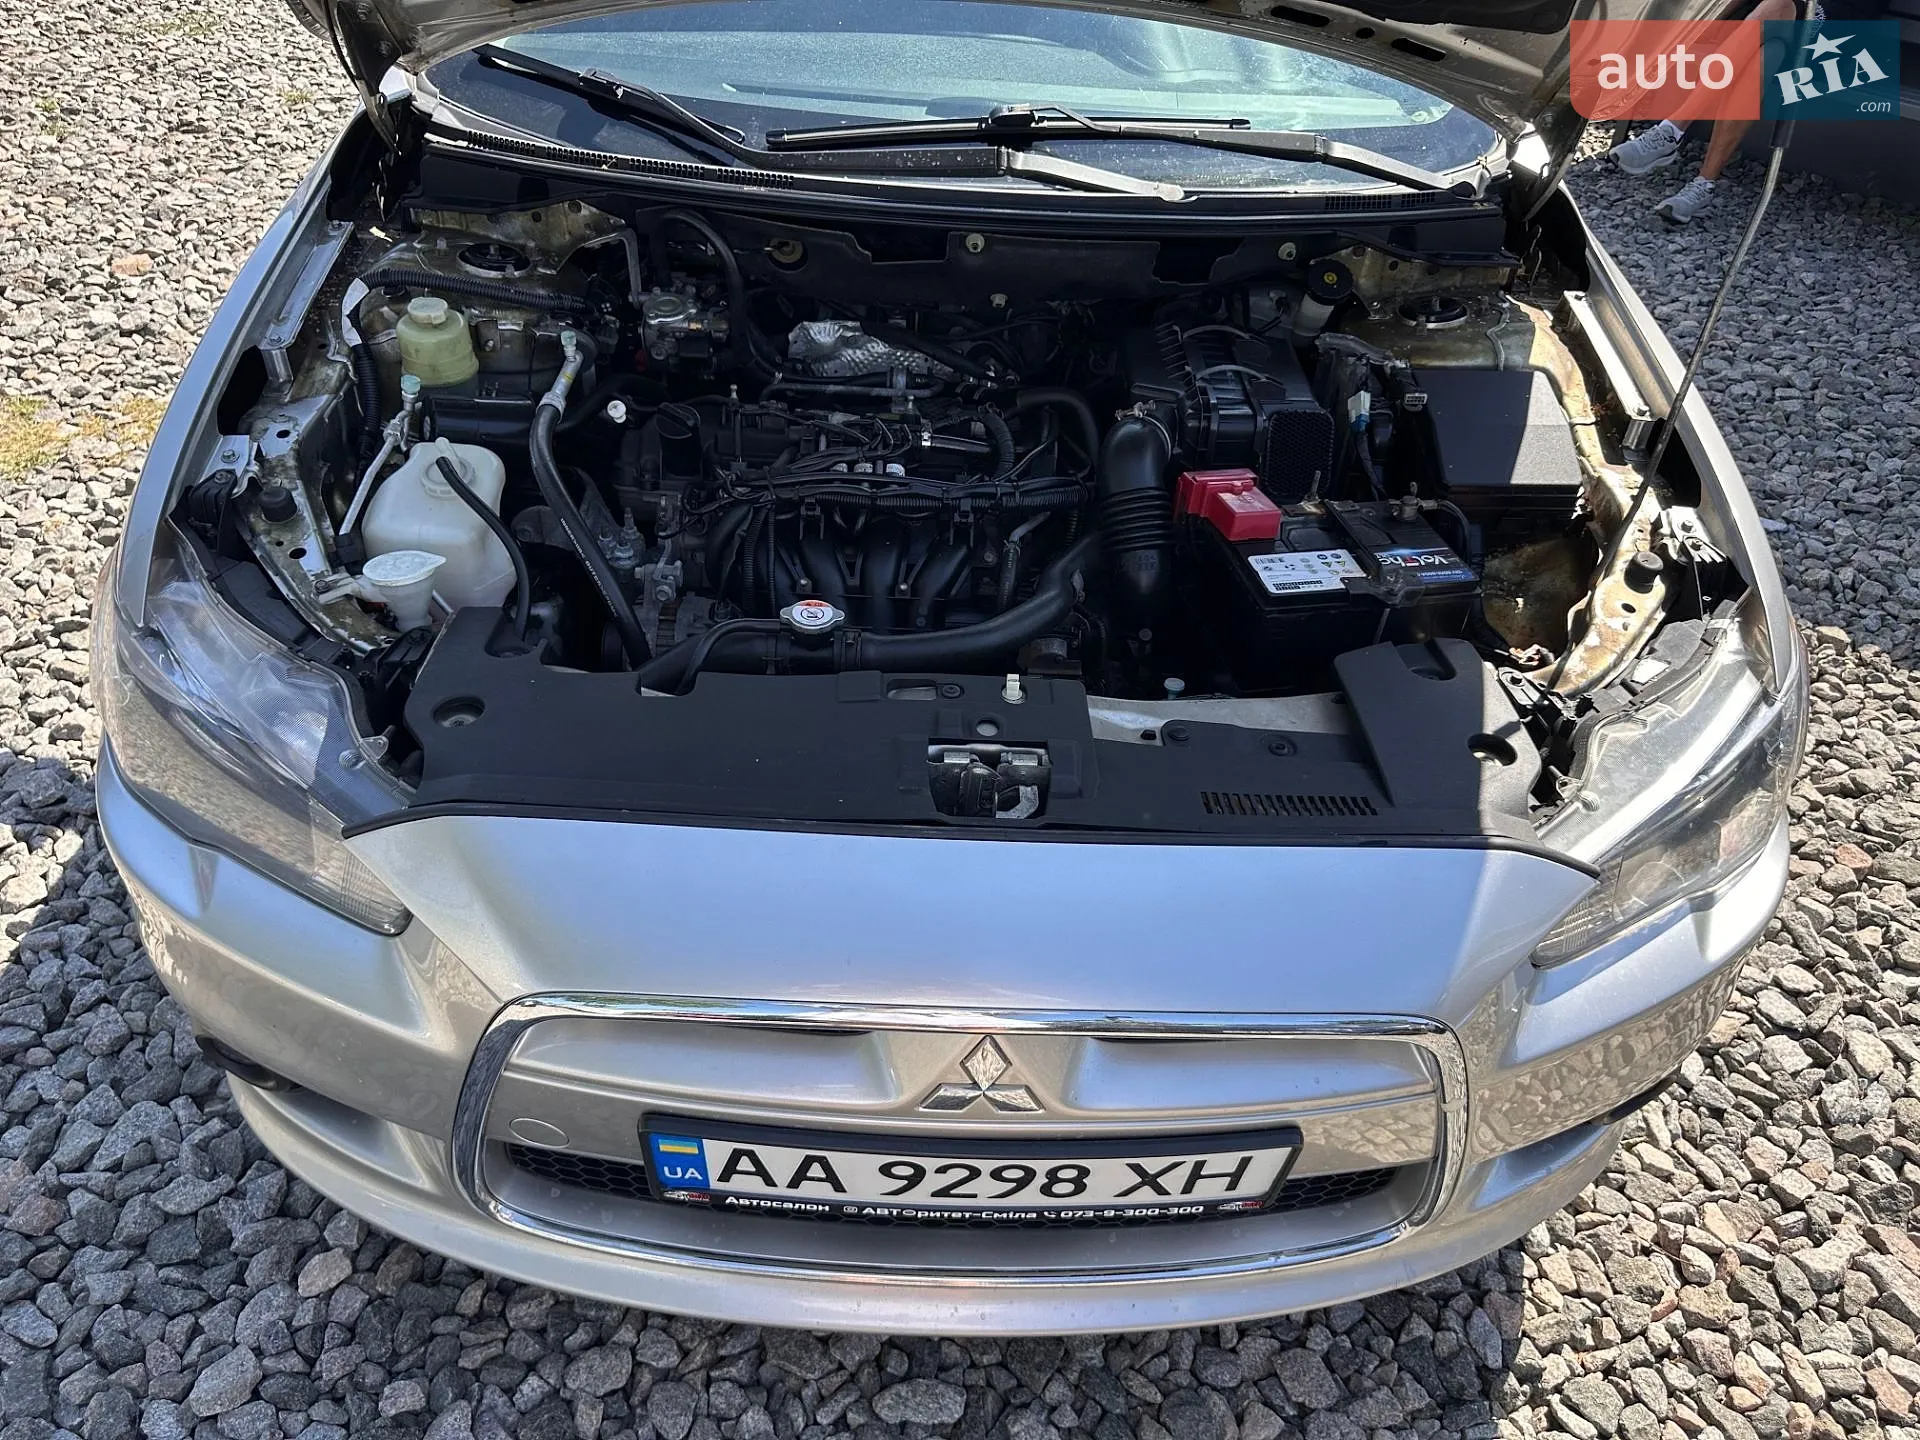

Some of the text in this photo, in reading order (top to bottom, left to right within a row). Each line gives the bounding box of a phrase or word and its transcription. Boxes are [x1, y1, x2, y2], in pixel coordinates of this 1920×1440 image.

[663, 1147, 1254, 1199] UA AA 9298 XH
[725, 1196, 830, 1212] Автосалон
[1060, 1204, 1205, 1218] 073-9-300-300
